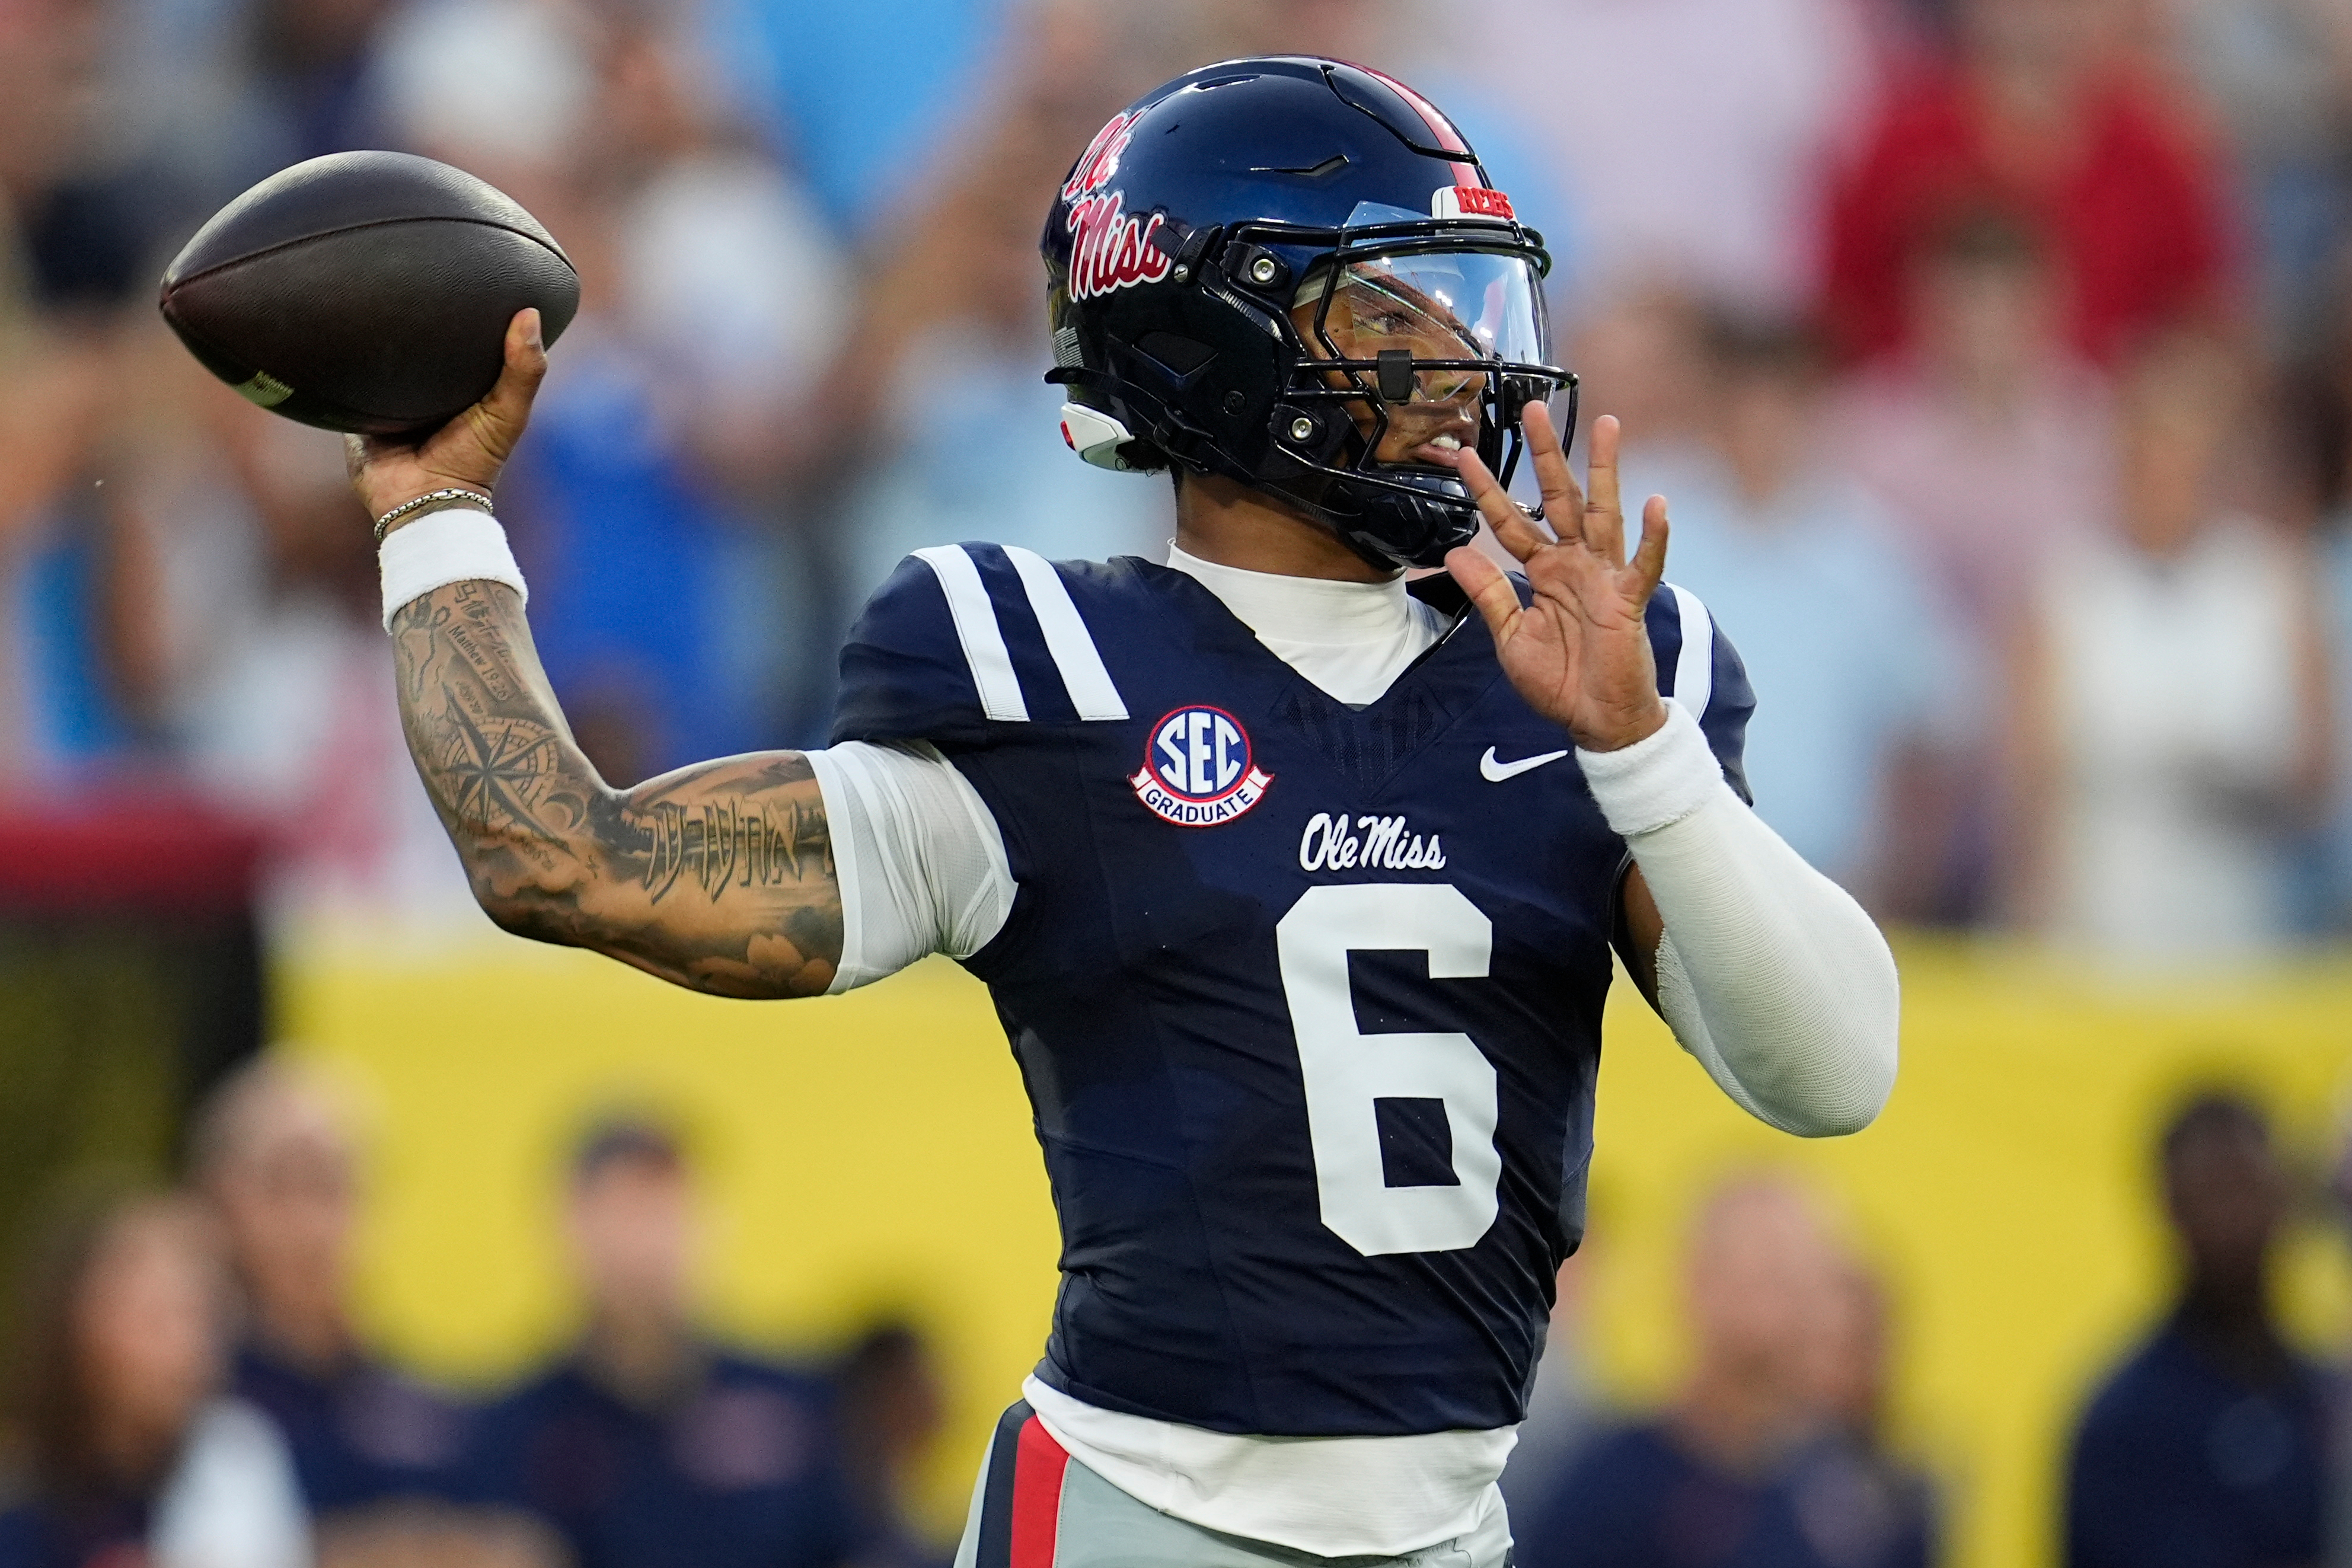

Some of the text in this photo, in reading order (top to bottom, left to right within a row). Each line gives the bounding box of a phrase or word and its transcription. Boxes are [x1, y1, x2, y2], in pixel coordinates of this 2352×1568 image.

[1062, 108, 1147, 202] Ole
[1067, 189, 1172, 304] Miss
[448, 624, 488, 666] Matthew
[1157, 711, 1242, 794] SEC
[1145, 788, 1253, 822] GRADUATE
[1300, 812, 1447, 871] Ole Miss
[1276, 883, 1502, 1256] 6
